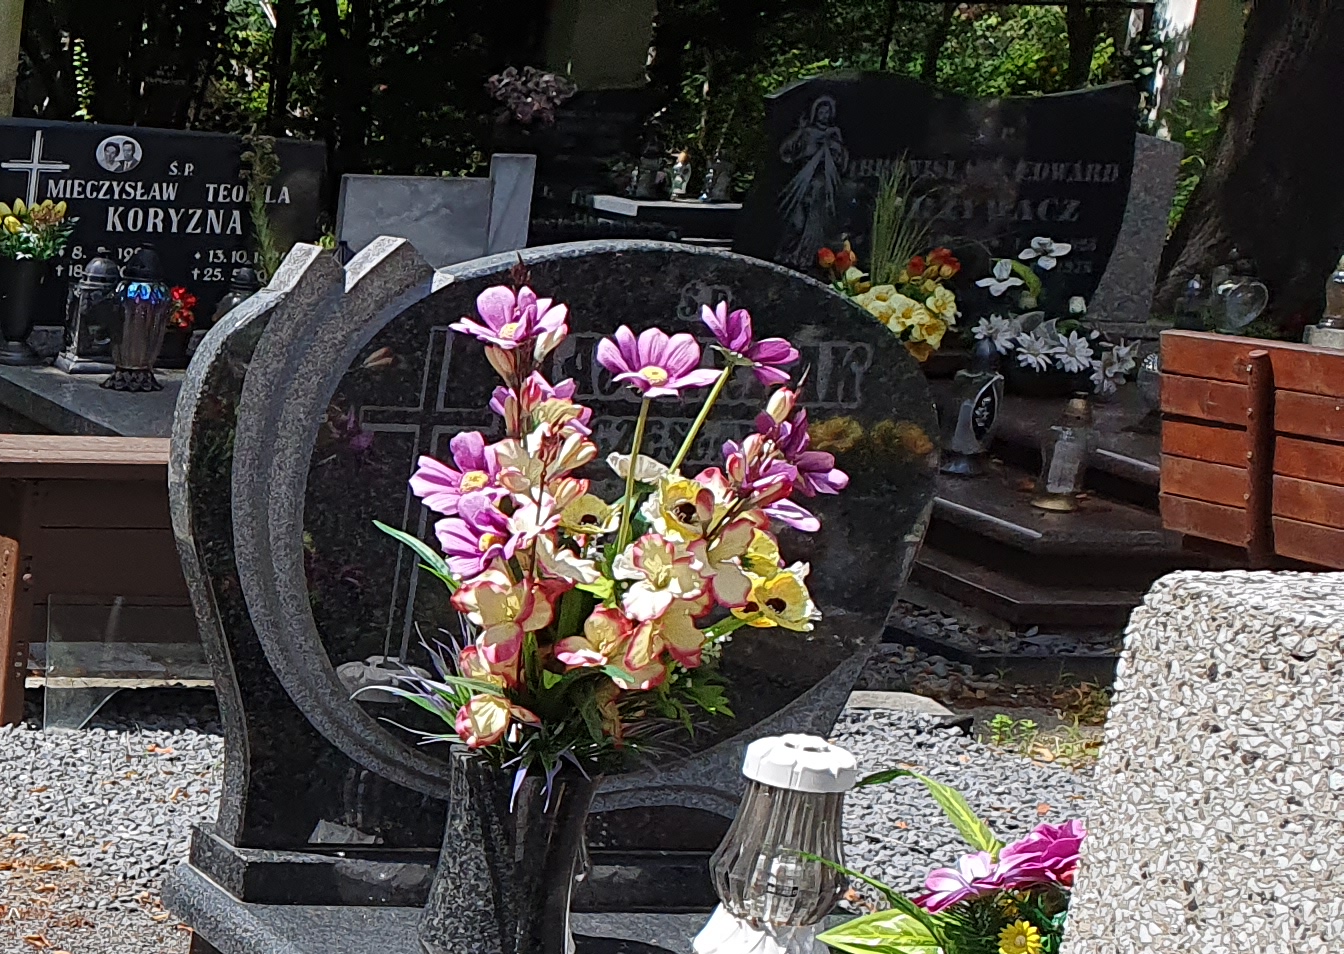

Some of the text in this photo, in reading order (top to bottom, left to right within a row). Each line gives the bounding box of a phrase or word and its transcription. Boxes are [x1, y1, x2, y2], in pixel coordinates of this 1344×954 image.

[47, 179, 291, 204] MIECZYSŁAW TEOLA
[105, 206, 243, 235] KORYZNA
